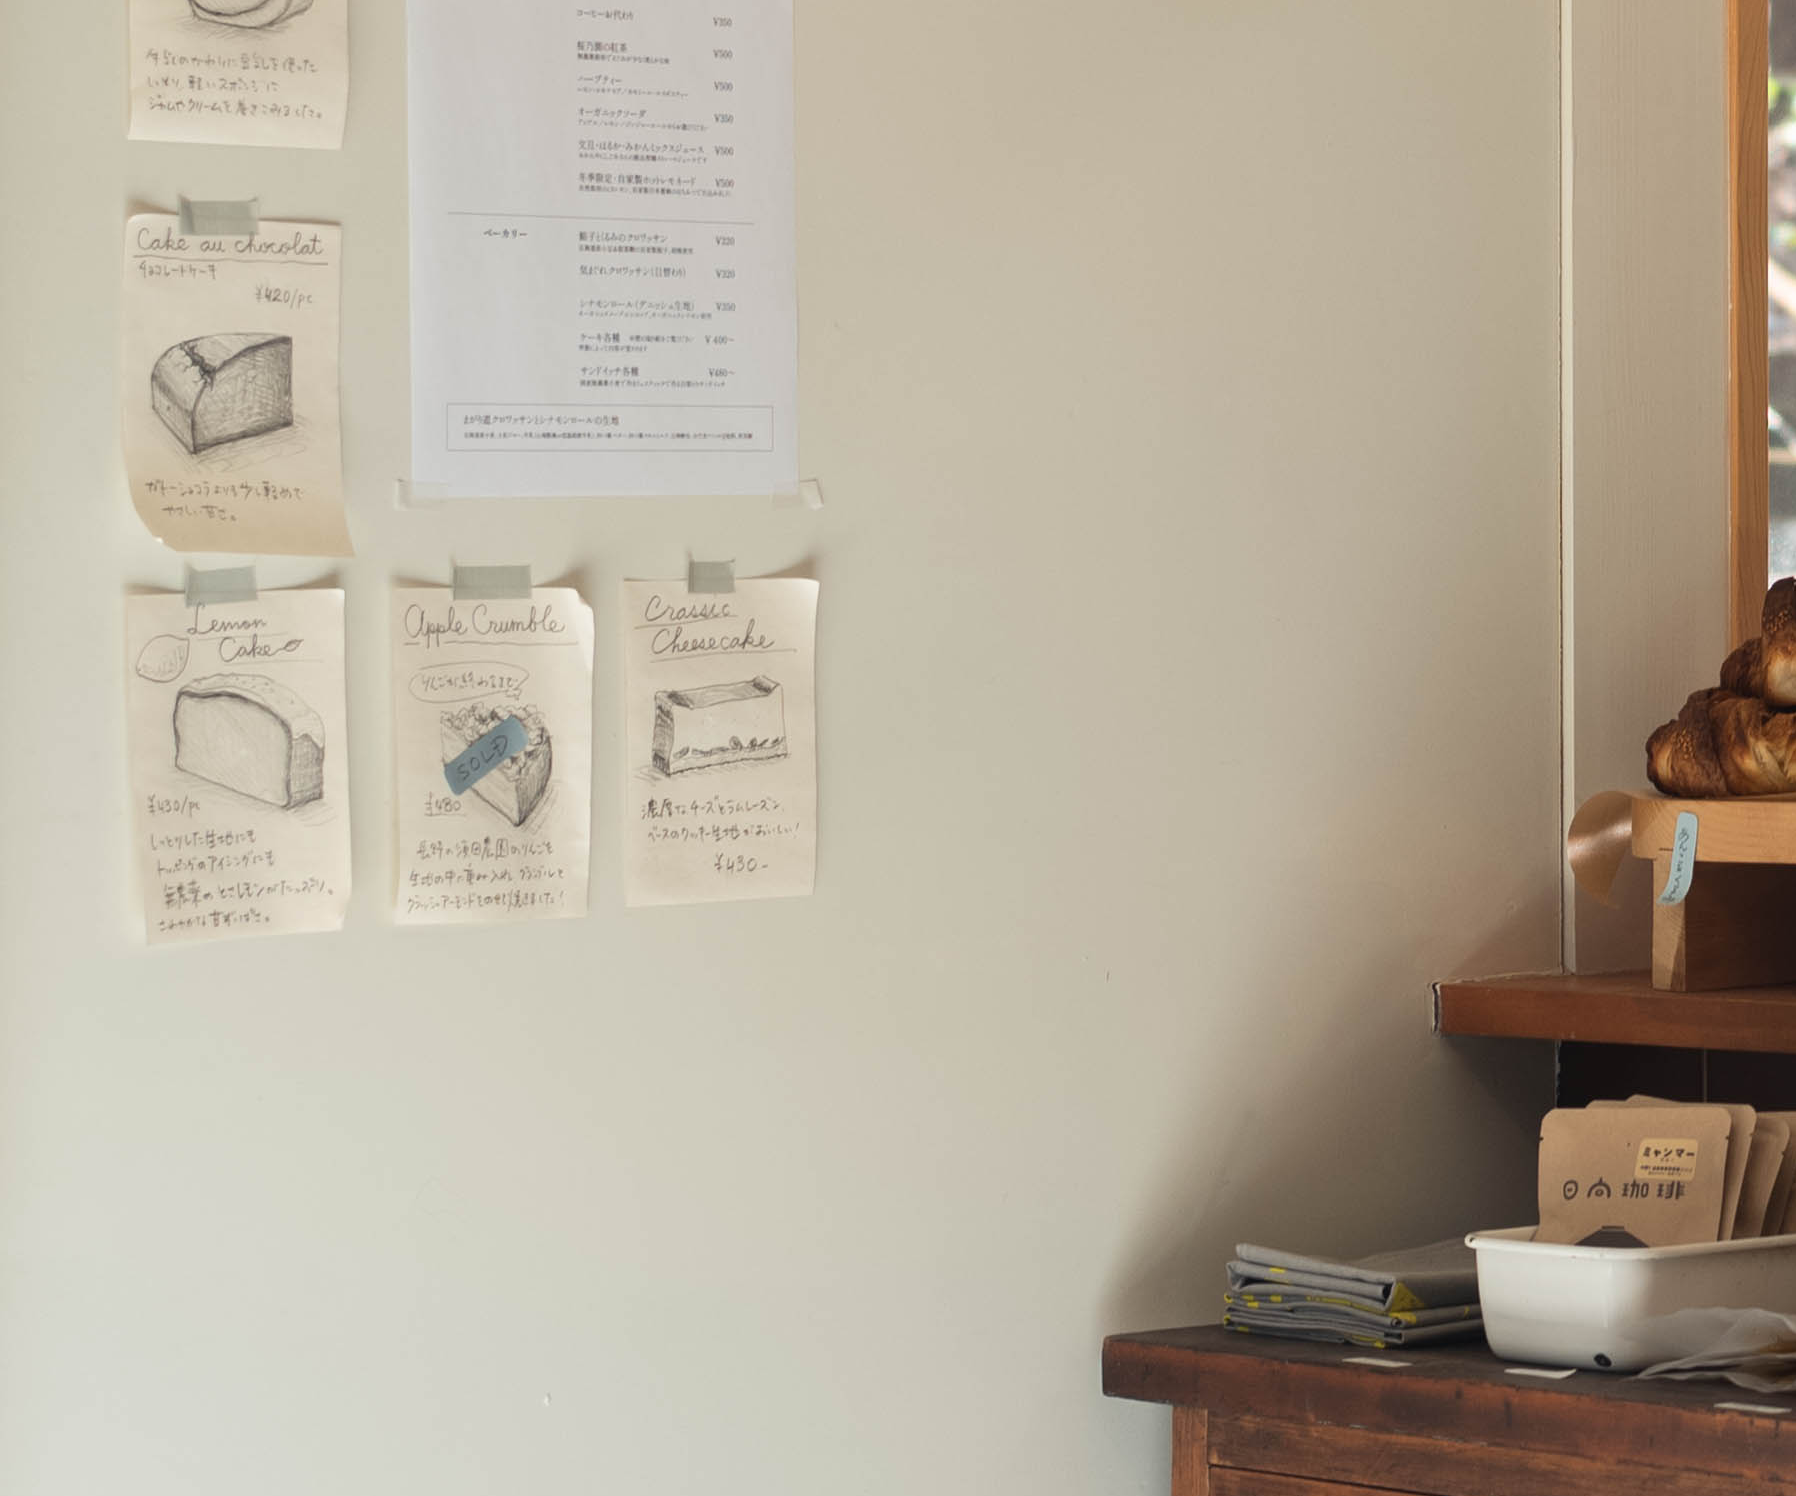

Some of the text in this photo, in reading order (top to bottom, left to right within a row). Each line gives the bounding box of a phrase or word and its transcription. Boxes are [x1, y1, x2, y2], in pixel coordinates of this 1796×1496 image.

[577, 74, 622, 85] ハーブティー
[578, 107, 647, 118] オーガニックソーダ
[137, 226, 324, 257] Cake au chocolat
[483, 227, 528, 240] ベーカリー
[580, 366, 640, 378] サンドイッチ各種
[186, 600, 268, 636] Lemon
[404, 603, 566, 649] Apple Crumble
[218, 633, 283, 663] Cake
[650, 617, 776, 656] Cheesecake
[456, 733, 510, 783] SOLD
[1642, 1145, 1696, 1158] ミャンマー
